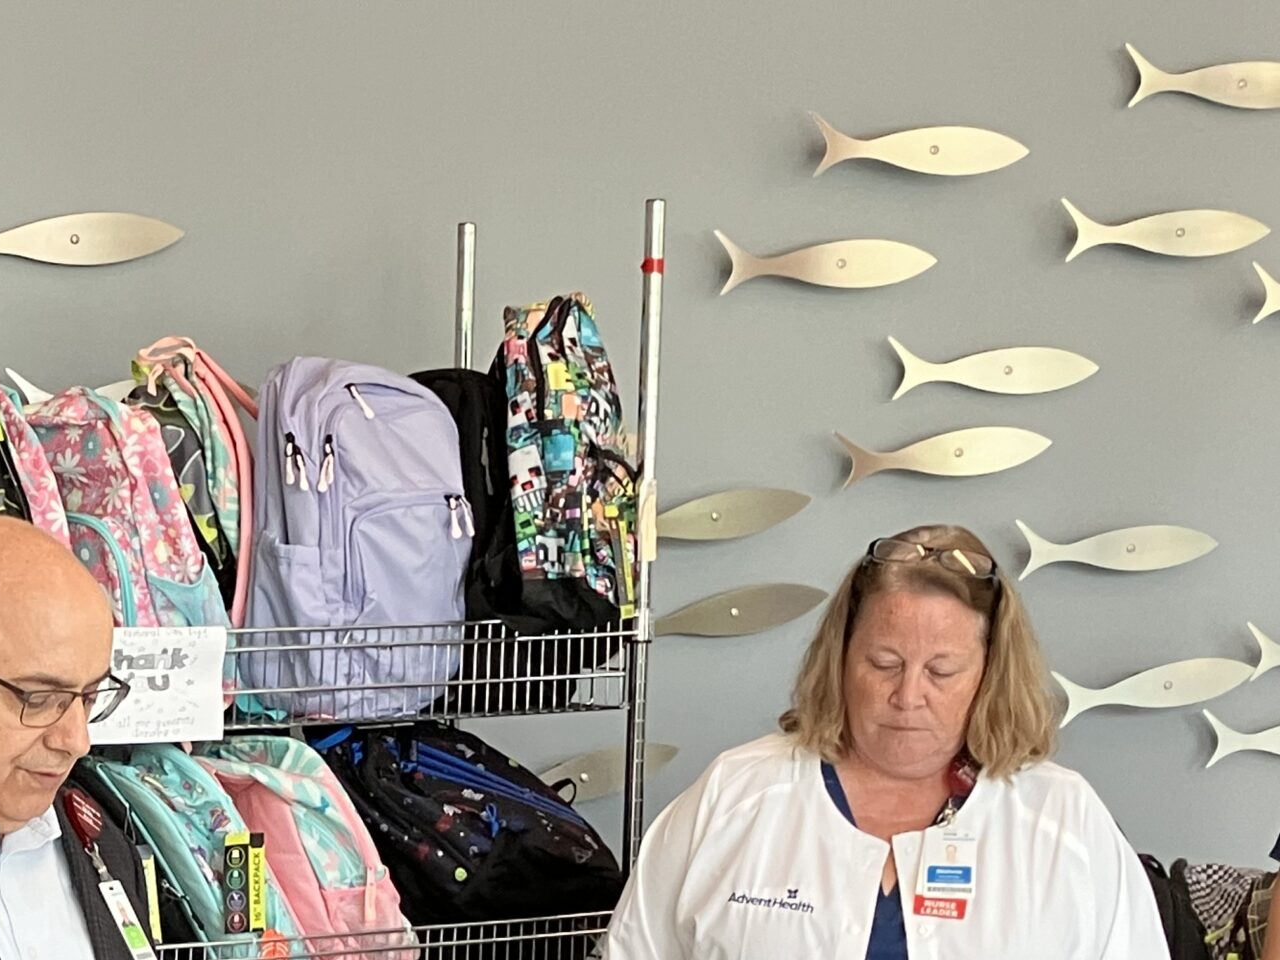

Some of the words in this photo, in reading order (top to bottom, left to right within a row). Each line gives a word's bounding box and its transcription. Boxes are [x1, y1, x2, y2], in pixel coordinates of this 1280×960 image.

[727, 891, 815, 914] AdventHealth
[924, 900, 957, 910] NURSE
[920, 907, 958, 917] LEADER
